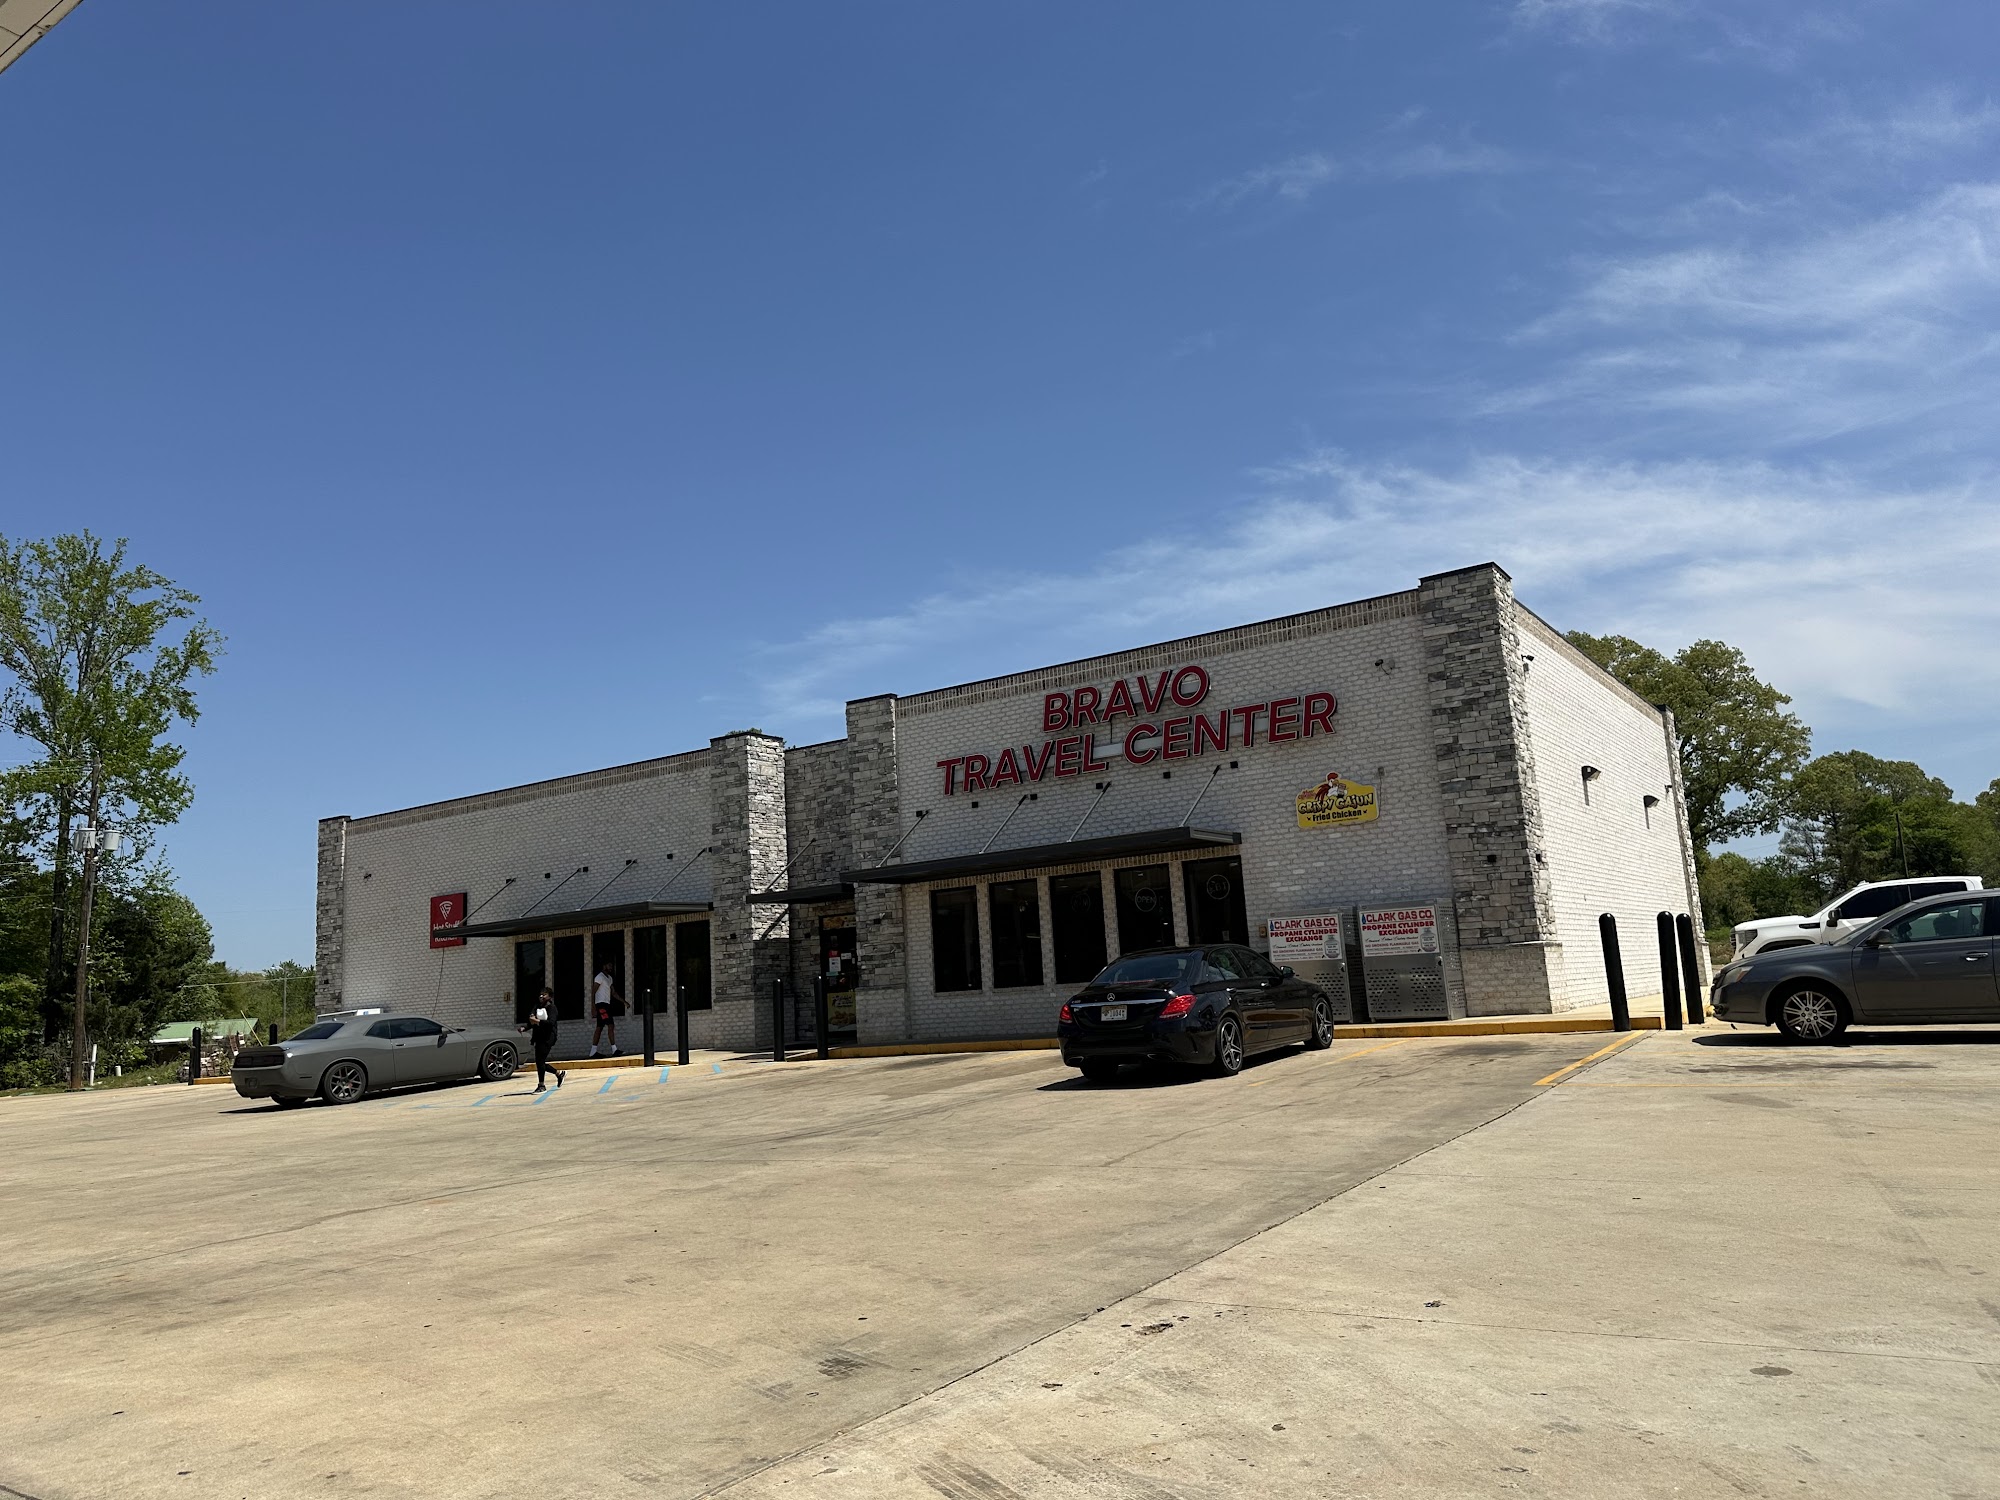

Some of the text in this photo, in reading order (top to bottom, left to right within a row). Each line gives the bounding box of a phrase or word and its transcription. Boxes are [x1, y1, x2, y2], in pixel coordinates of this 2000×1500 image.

[1042, 665, 1210, 732] BRAVO
[936, 691, 1338, 796] TRAVEL CENTER
[1312, 812, 1331, 822] Fried
[1332, 809, 1362, 819] Chicken
[1366, 909, 1434, 923] CLARK GAS CO.
[1274, 919, 1302, 929] CLARK
[1303, 918, 1323, 928] GAS
[1362, 923, 1397, 931] PROPANE
[1270, 928, 1338, 938] PROPANE CYLINDER
[1379, 928, 1419, 936] EXCHANGE
[1285, 935, 1323, 943] EXCHANGE
